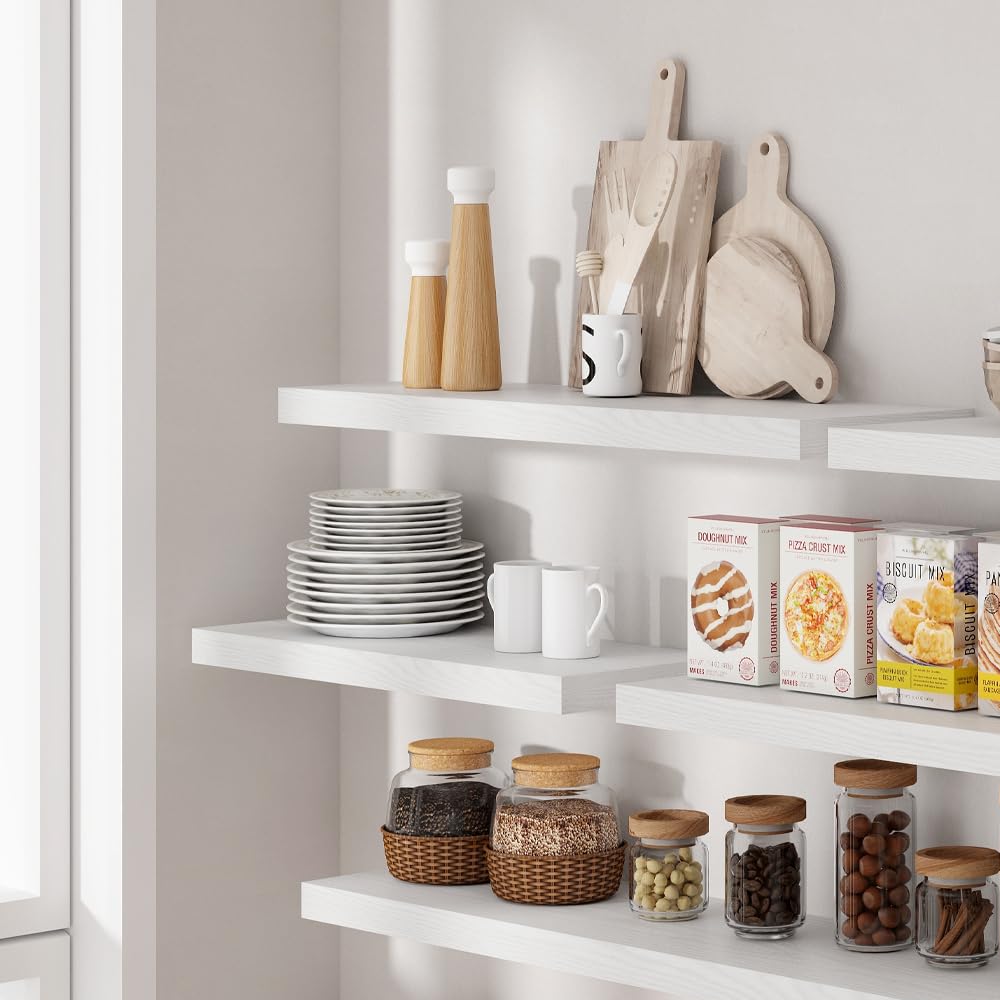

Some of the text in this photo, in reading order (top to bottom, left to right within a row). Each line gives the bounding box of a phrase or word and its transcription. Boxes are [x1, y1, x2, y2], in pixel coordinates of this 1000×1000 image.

[698, 532, 747, 545] DOUGHNUT MIX
[788, 540, 846, 554] PIZZA CRUST MIX
[886, 561, 945, 581] BISCUIT MIX
[964, 573, 975, 655] BISCUIT MIX
